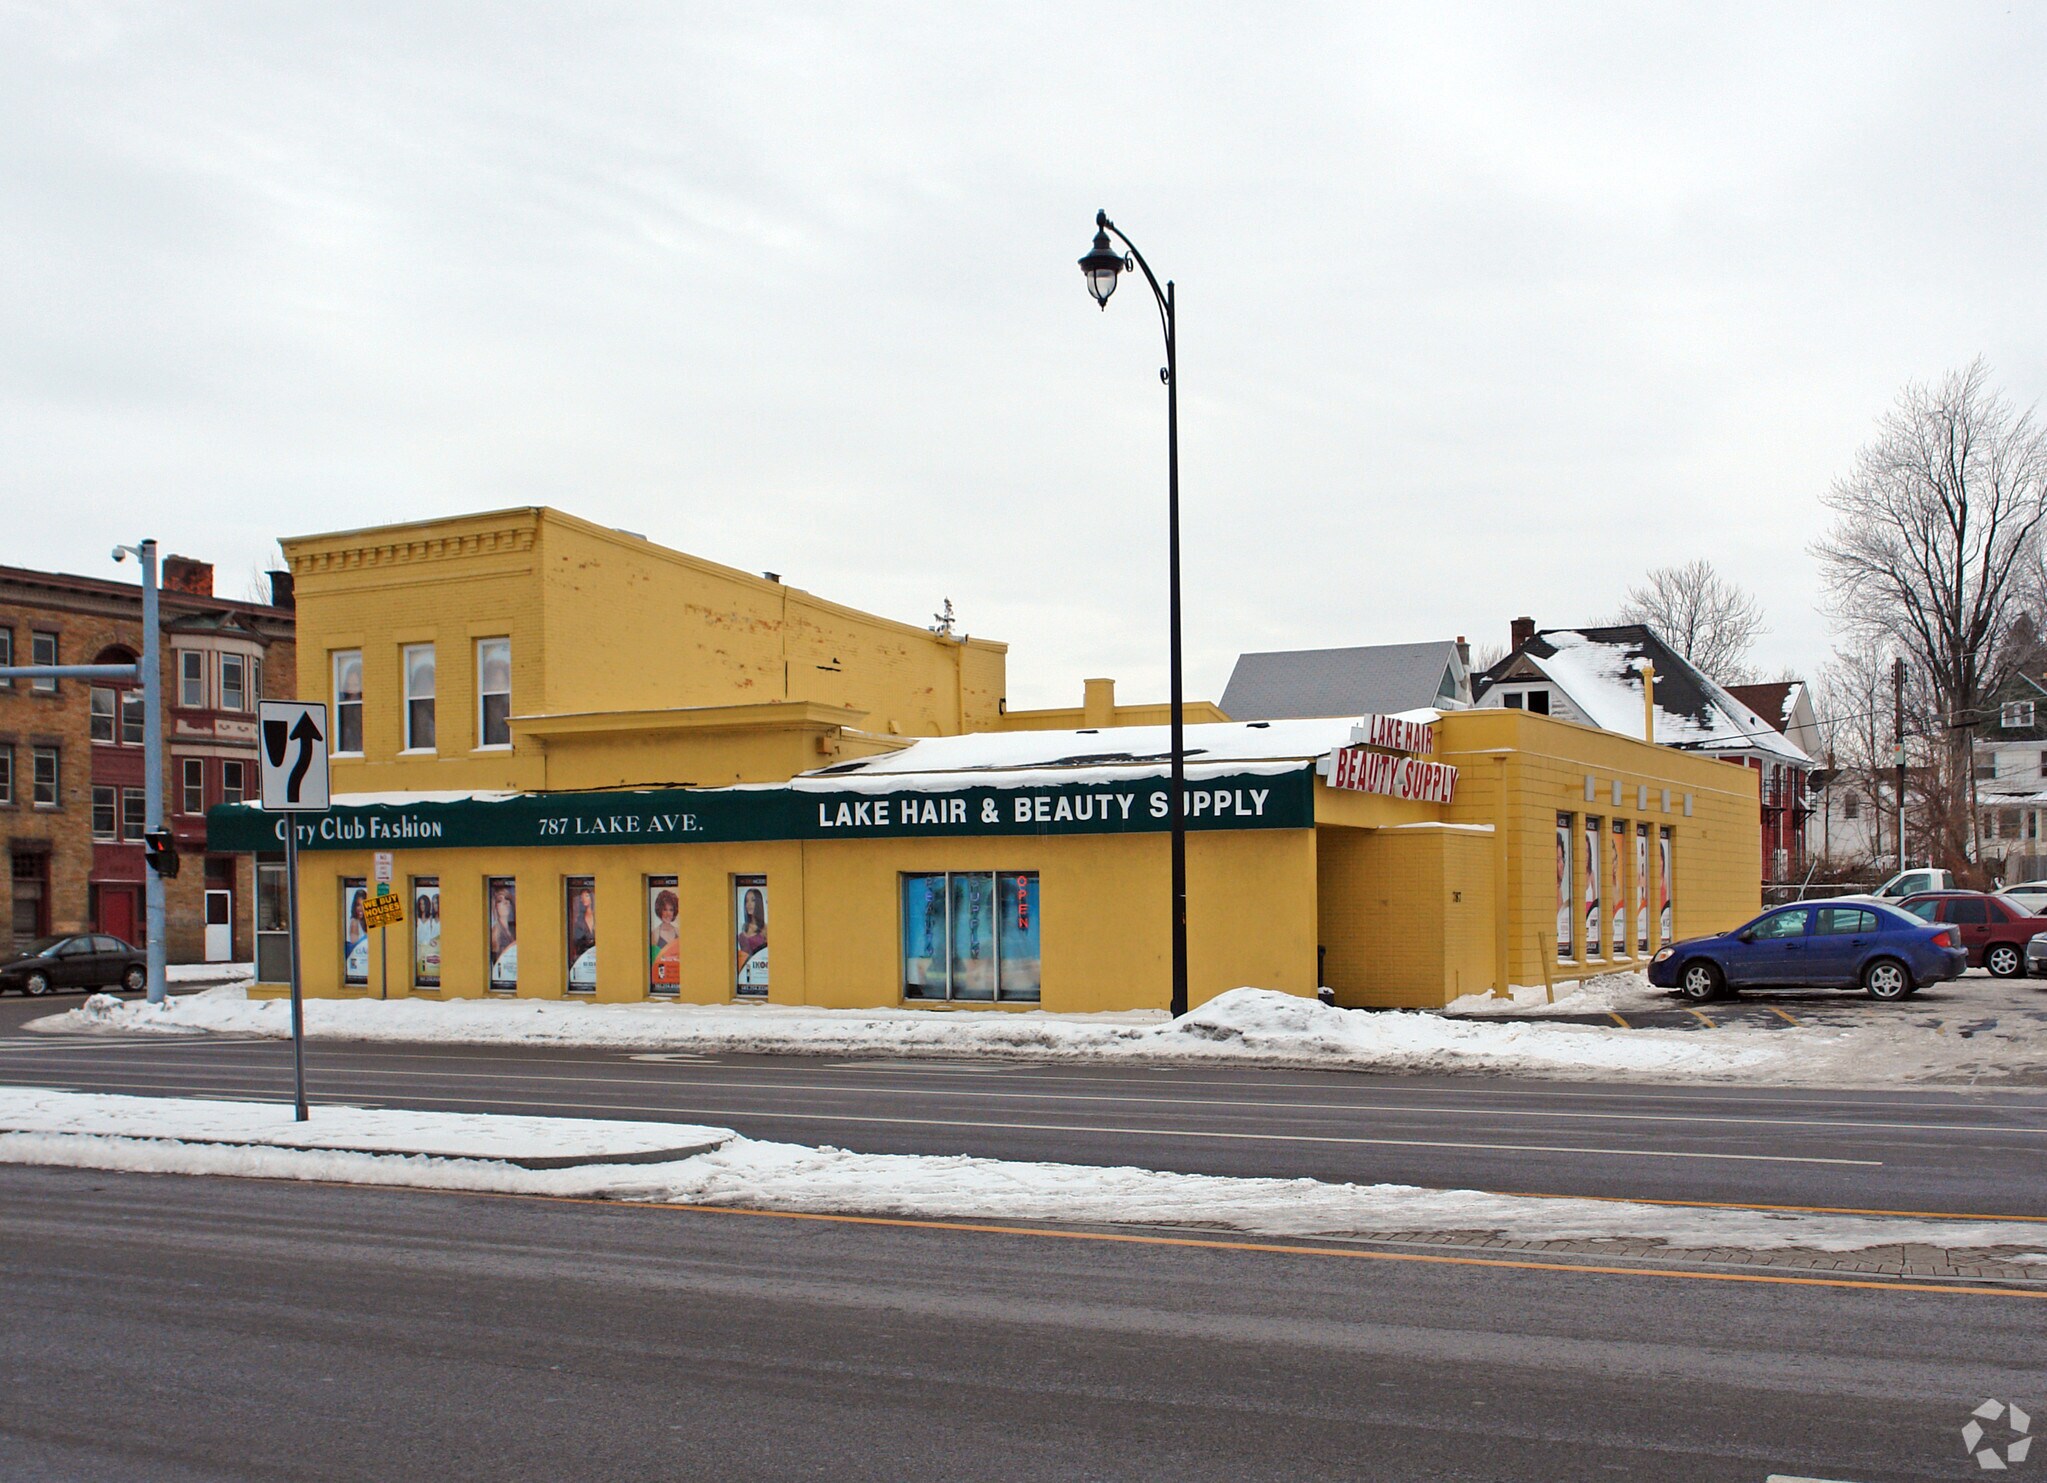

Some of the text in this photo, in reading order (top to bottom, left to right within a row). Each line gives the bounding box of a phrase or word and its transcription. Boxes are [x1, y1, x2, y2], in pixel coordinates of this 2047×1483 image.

[1369, 713, 1434, 755] LAKE HAIR
[1335, 747, 1458, 804] BEAUTY SUPPLY
[819, 789, 1270, 827] LAKE HAIR & BEAUTY SPPLY
[320, 815, 365, 840] Club
[538, 813, 704, 836] 787 LAKE AVE.
[363, 895, 398, 909] WE BUY
[365, 902, 400, 917] HOUSES
[1016, 875, 1029, 929] OPEN
